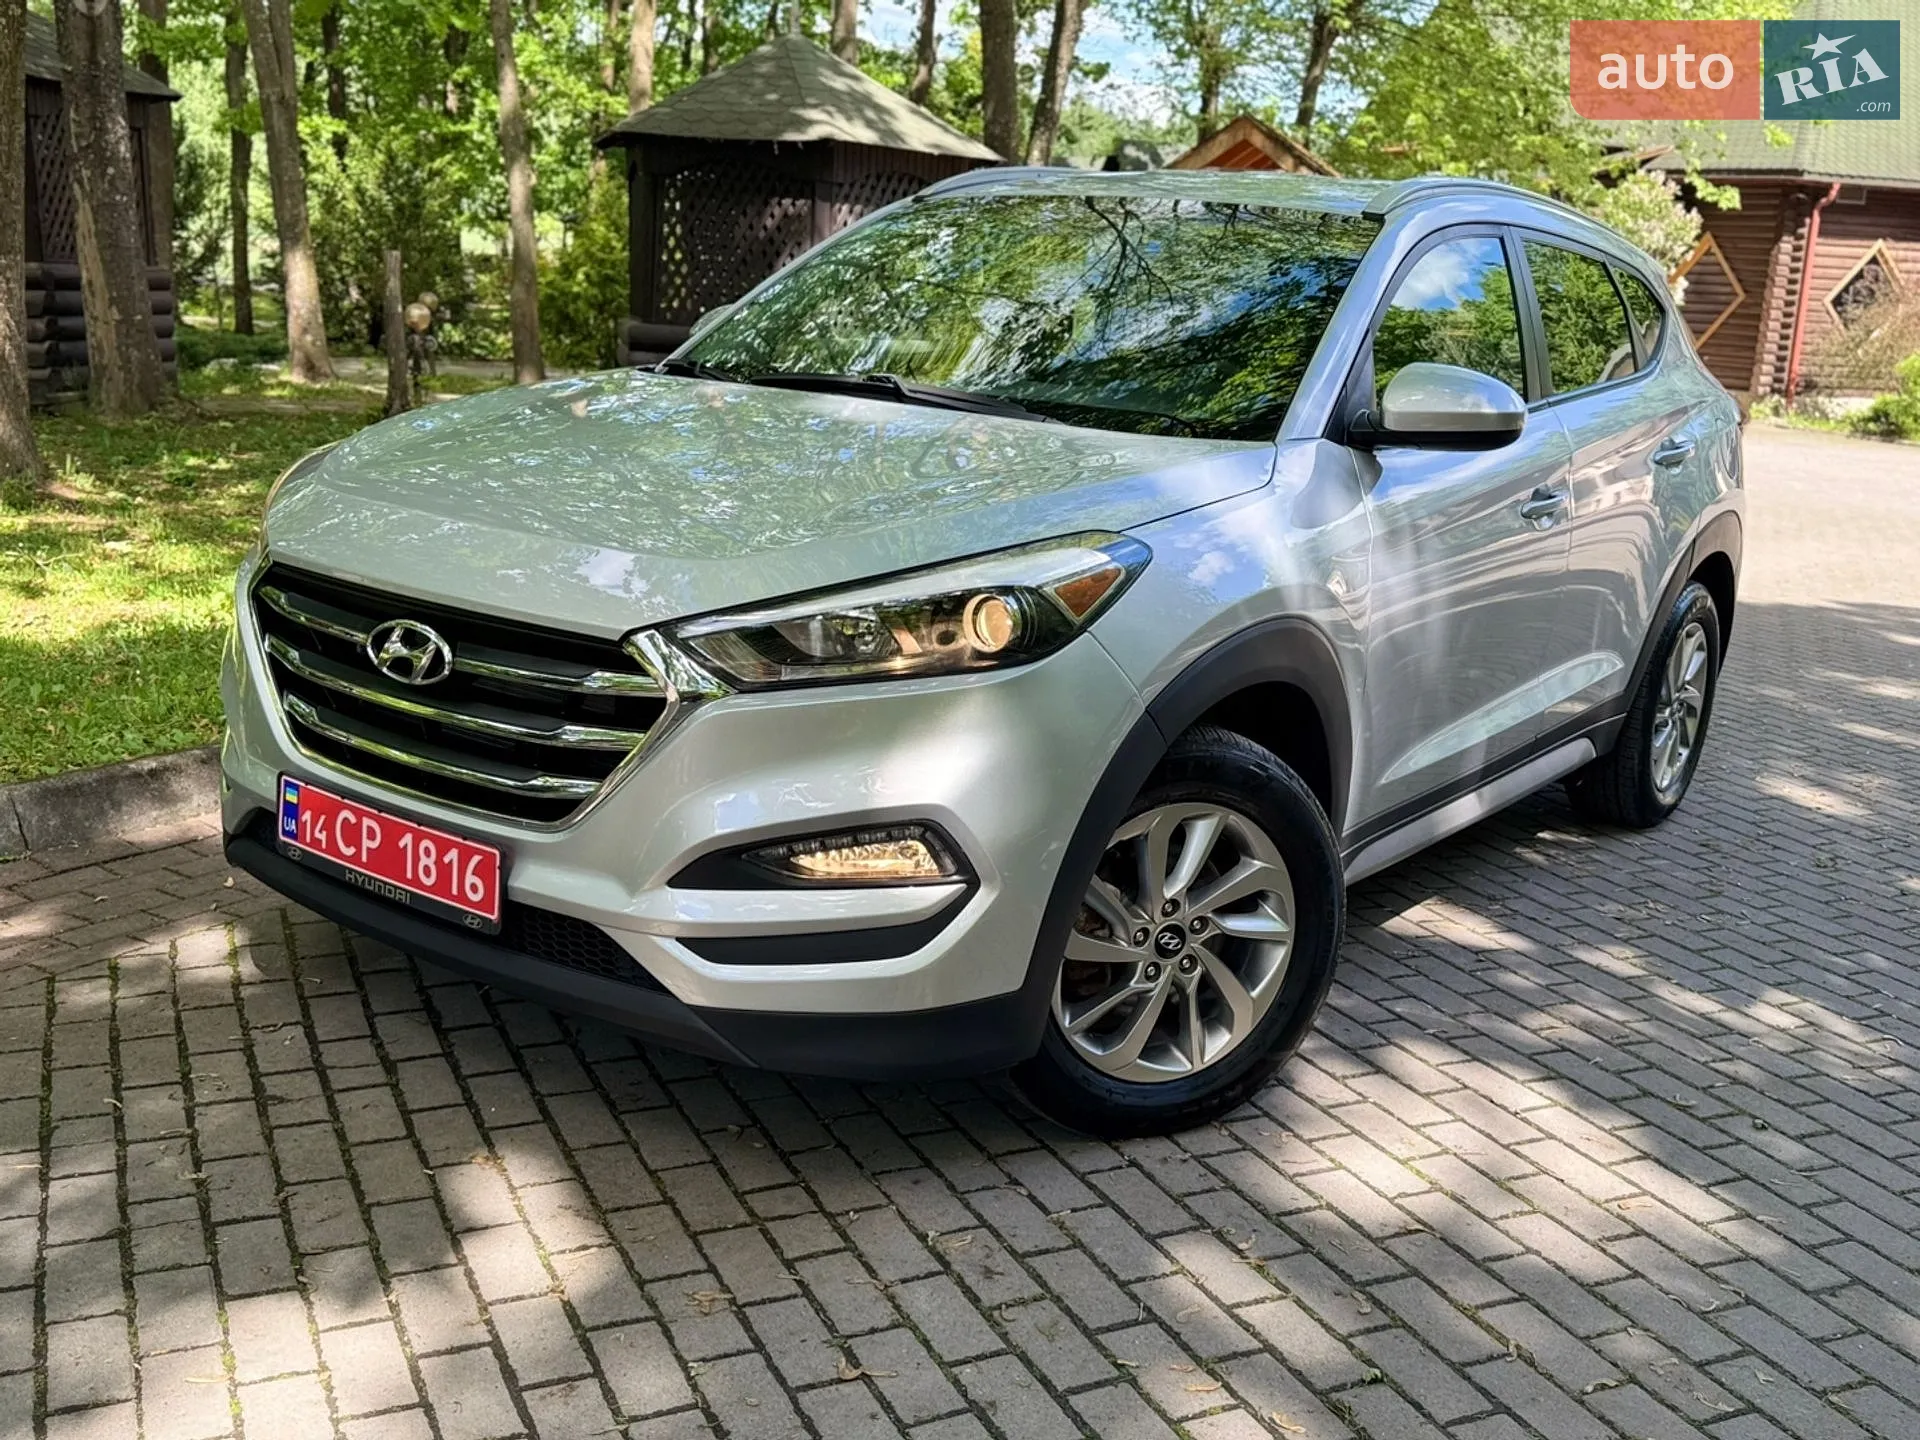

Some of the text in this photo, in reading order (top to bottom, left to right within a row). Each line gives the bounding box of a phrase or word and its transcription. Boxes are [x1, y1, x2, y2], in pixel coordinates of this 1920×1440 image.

[284, 816, 297, 834] UA
[301, 809, 485, 902] 14 CP 1816
[345, 869, 411, 905] HYUNDAI
